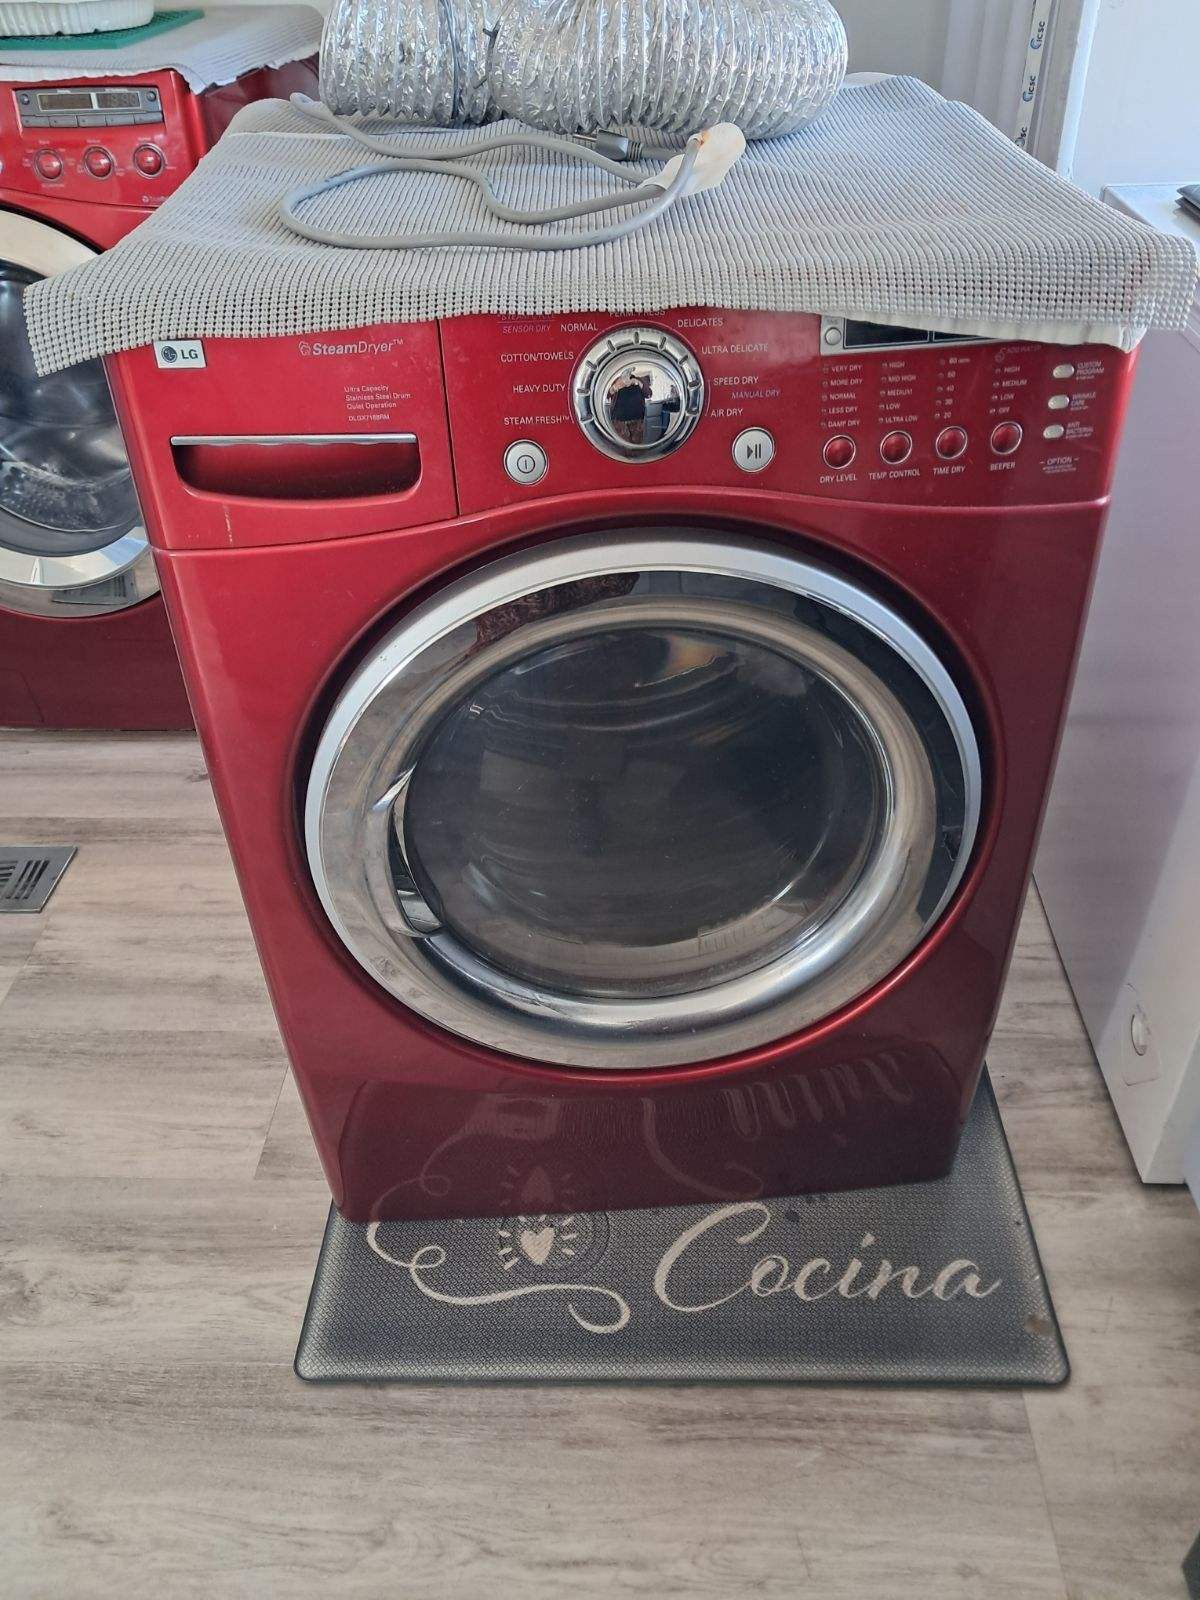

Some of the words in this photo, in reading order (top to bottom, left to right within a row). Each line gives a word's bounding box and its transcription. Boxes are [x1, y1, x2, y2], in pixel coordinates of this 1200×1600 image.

[560, 323, 598, 332] NORMAL
[677, 317, 724, 328] DELICATES
[502, 325, 533, 334] SENSOR
[180, 348, 199, 360] LG
[701, 345, 729, 355] ULTRA
[730, 343, 769, 353] DELICATE
[500, 351, 575, 363] COTTON/TOWELS
[713, 377, 740, 386] SPEED
[741, 376, 759, 385] DRY
[830, 379, 848, 387] MORE
[361, 384, 389, 393] Capacity
[512, 385, 541, 394] HEAVY
[542, 383, 566, 393] DUTY
[887, 389, 913, 397] MEDIUM
[345, 394, 375, 402] Stainless
[731, 391, 763, 399] MANUAL
[764, 389, 780, 398] DRY
[829, 393, 857, 401] NORMAL
[346, 403, 365, 411] Quiet
[365, 402, 398, 410] Operation
[828, 407, 845, 415] LESS
[885, 403, 901, 411] LOW
[711, 408, 726, 418] AIR
[726, 407, 743, 417] DRY
[504, 416, 535, 427] STEAM
[827, 420, 847, 429] DAMP
[847, 420, 861, 428] DRY
[885, 416, 904, 424] ULTRA
[904, 415, 919, 423] LOW
[990, 461, 1016, 471] BEEPER
[1046, 456, 1073, 466] OPTION
[869, 472, 888, 481] TEMP
[888, 468, 920, 479] CONTROL
[932, 466, 950, 476] TIME
[950, 464, 966, 474] DRY
[819, 475, 836, 484] DRY
[836, 473, 858, 482] LEVEL
[654, 1201, 1002, 1313] Cocina
